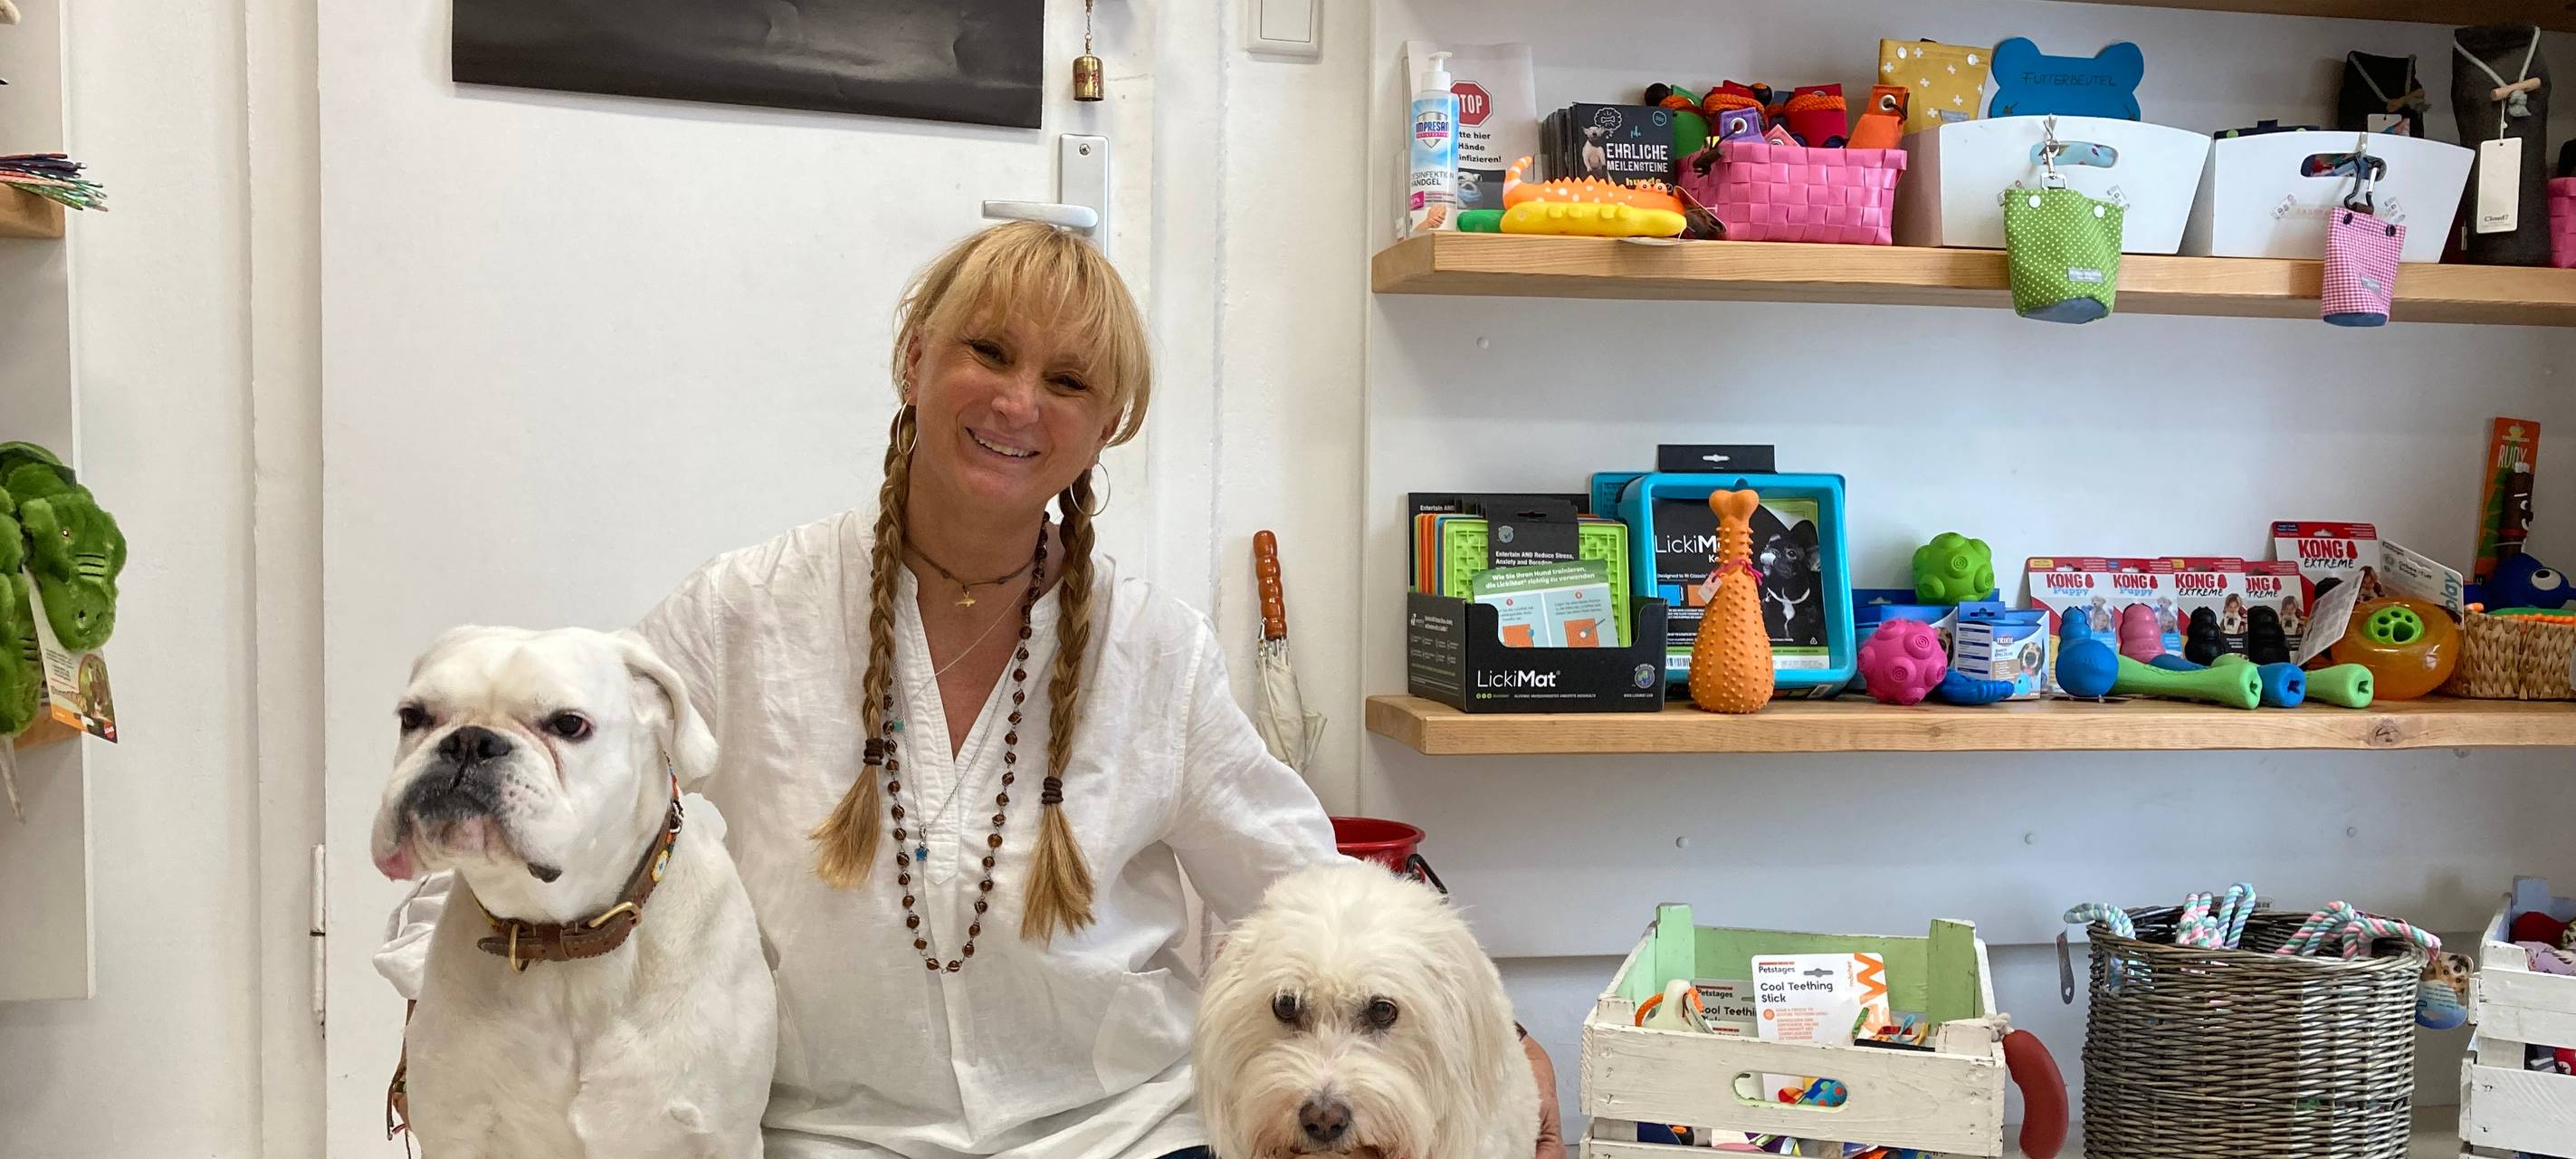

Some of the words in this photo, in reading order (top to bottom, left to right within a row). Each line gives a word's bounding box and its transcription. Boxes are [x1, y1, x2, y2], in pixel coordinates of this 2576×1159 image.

[1459, 93, 1483, 114] TOP
[1474, 131, 1491, 139] hier
[1606, 143, 1668, 160] EHRLICHE
[1458, 154, 1502, 163] infizieren!
[1607, 160, 1668, 173] MEILENSTEINE
[1655, 534, 1720, 553] LickiM
[2297, 539, 2344, 559] KONG
[2304, 558, 2354, 569] EXTREME
[1516, 570, 1533, 579] Ihren
[1534, 569, 1551, 577] Hund
[1552, 567, 1587, 576] trainieren,
[1528, 578, 1550, 586] richtig
[1559, 572, 1595, 582] verwenden
[2046, 573, 2083, 589] KONG
[2113, 574, 2148, 589] KONG
[2175, 573, 2215, 589] KONG
[2246, 577, 2271, 591] ONG
[2053, 588, 2089, 597] Puppy
[2119, 588, 2153, 597] Puppy
[2179, 588, 2224, 597] EXTREME
[1476, 670, 1557, 687] LickiMat
[1758, 965, 1796, 975] Petstages
[1760, 982, 1785, 991] Cool
[1788, 982, 1834, 992] Teething
[1696, 988, 1733, 999] Petstages
[1761, 993, 1787, 1003] Stick
[1703, 1005, 1721, 1015] ool
[1723, 1006, 1757, 1016] Teethi
